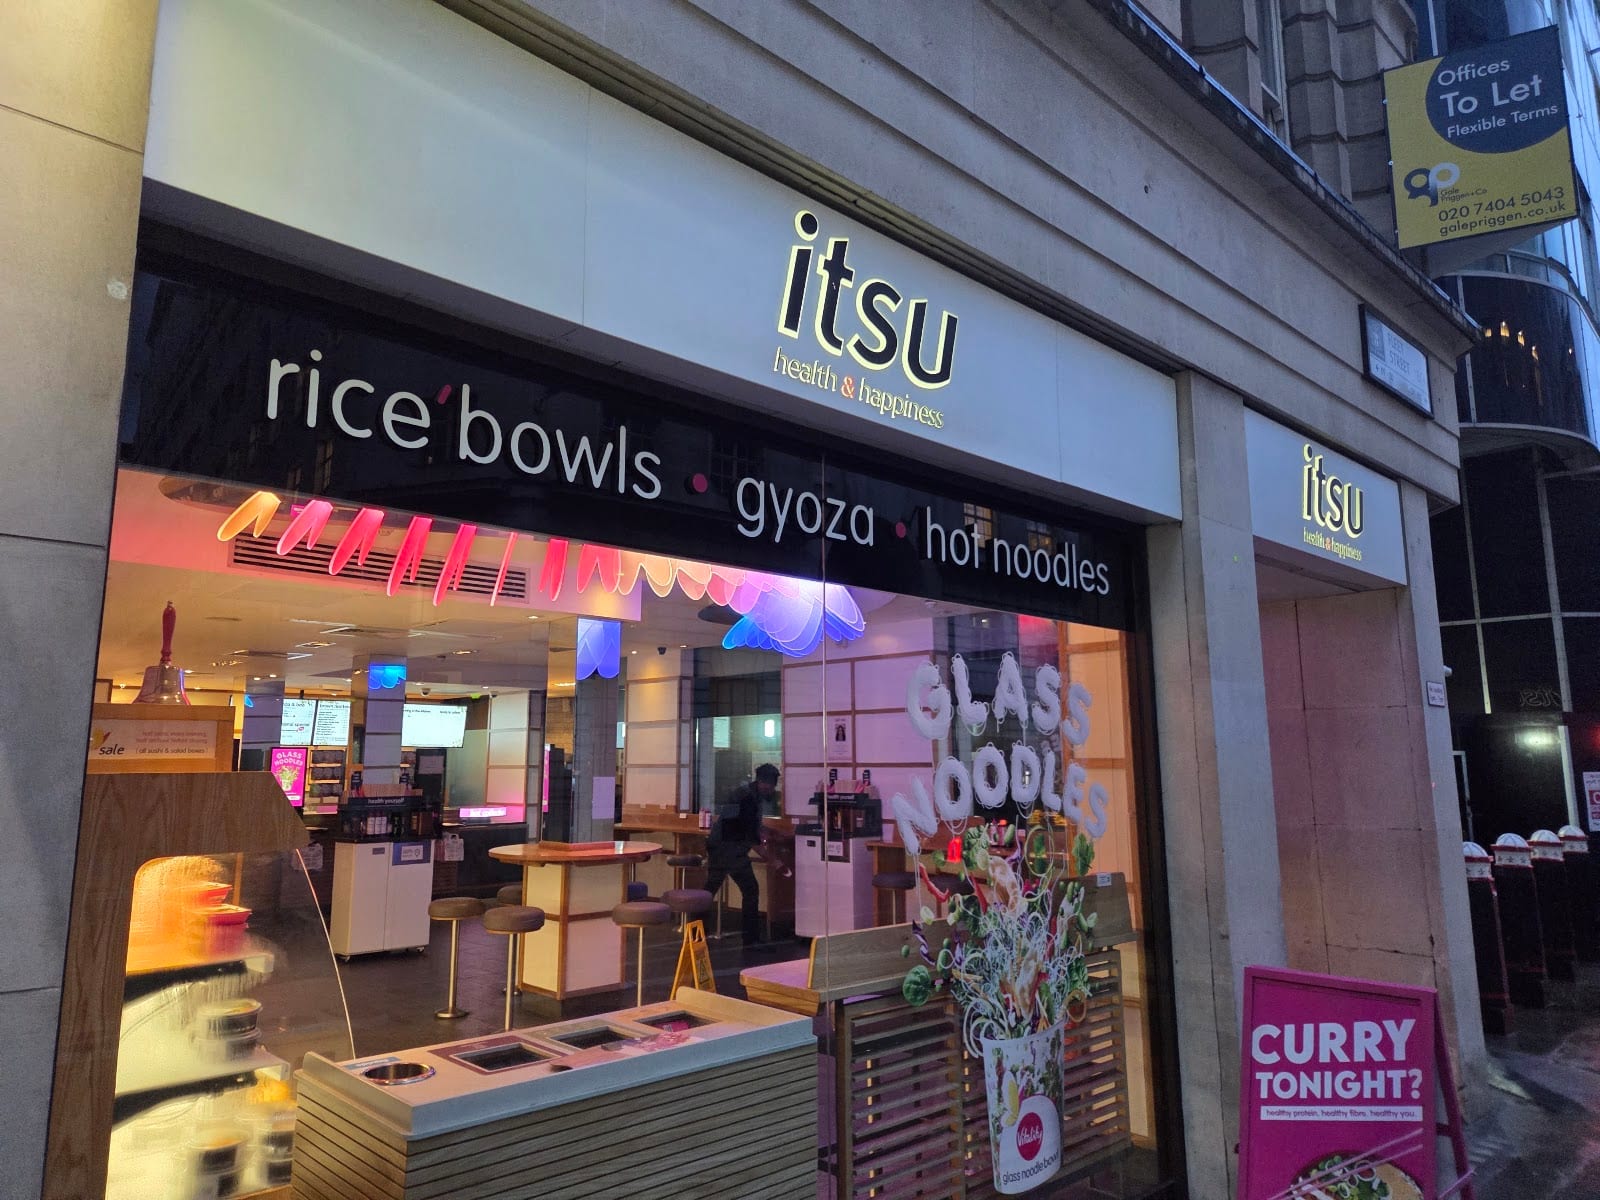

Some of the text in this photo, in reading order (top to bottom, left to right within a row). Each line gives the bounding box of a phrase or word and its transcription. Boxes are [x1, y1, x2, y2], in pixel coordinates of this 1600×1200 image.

[1438, 60, 1510, 86] Offices
[1440, 74, 1542, 117] To Let
[1447, 105, 1558, 138] Flexible Terms
[1438, 186, 1565, 222] 020 7404 5043
[1440, 201, 1566, 236] galepriggen.co.uk
[778, 209, 958, 390] itsu
[773, 346, 945, 429] health & happiness
[1302, 444, 1364, 538] itsu
[736, 477, 874, 547] gyoza
[926, 506, 1110, 596] hot noodles
[906, 651, 1092, 746] GLASS
[99, 743, 125, 756] sale
[276, 751, 303, 760] GLASS
[892, 741, 1108, 856] NOODLES
[1251, 1018, 1416, 1065] CURRY
[1255, 1068, 1423, 1100] TONIGHT?
[1266, 1108, 1292, 1117] healthy
[1321, 1109, 1349, 1117] healthy
[1370, 1109, 1399, 1118] healthy
[1002, 1149, 1059, 1185] glass noodle bowl
